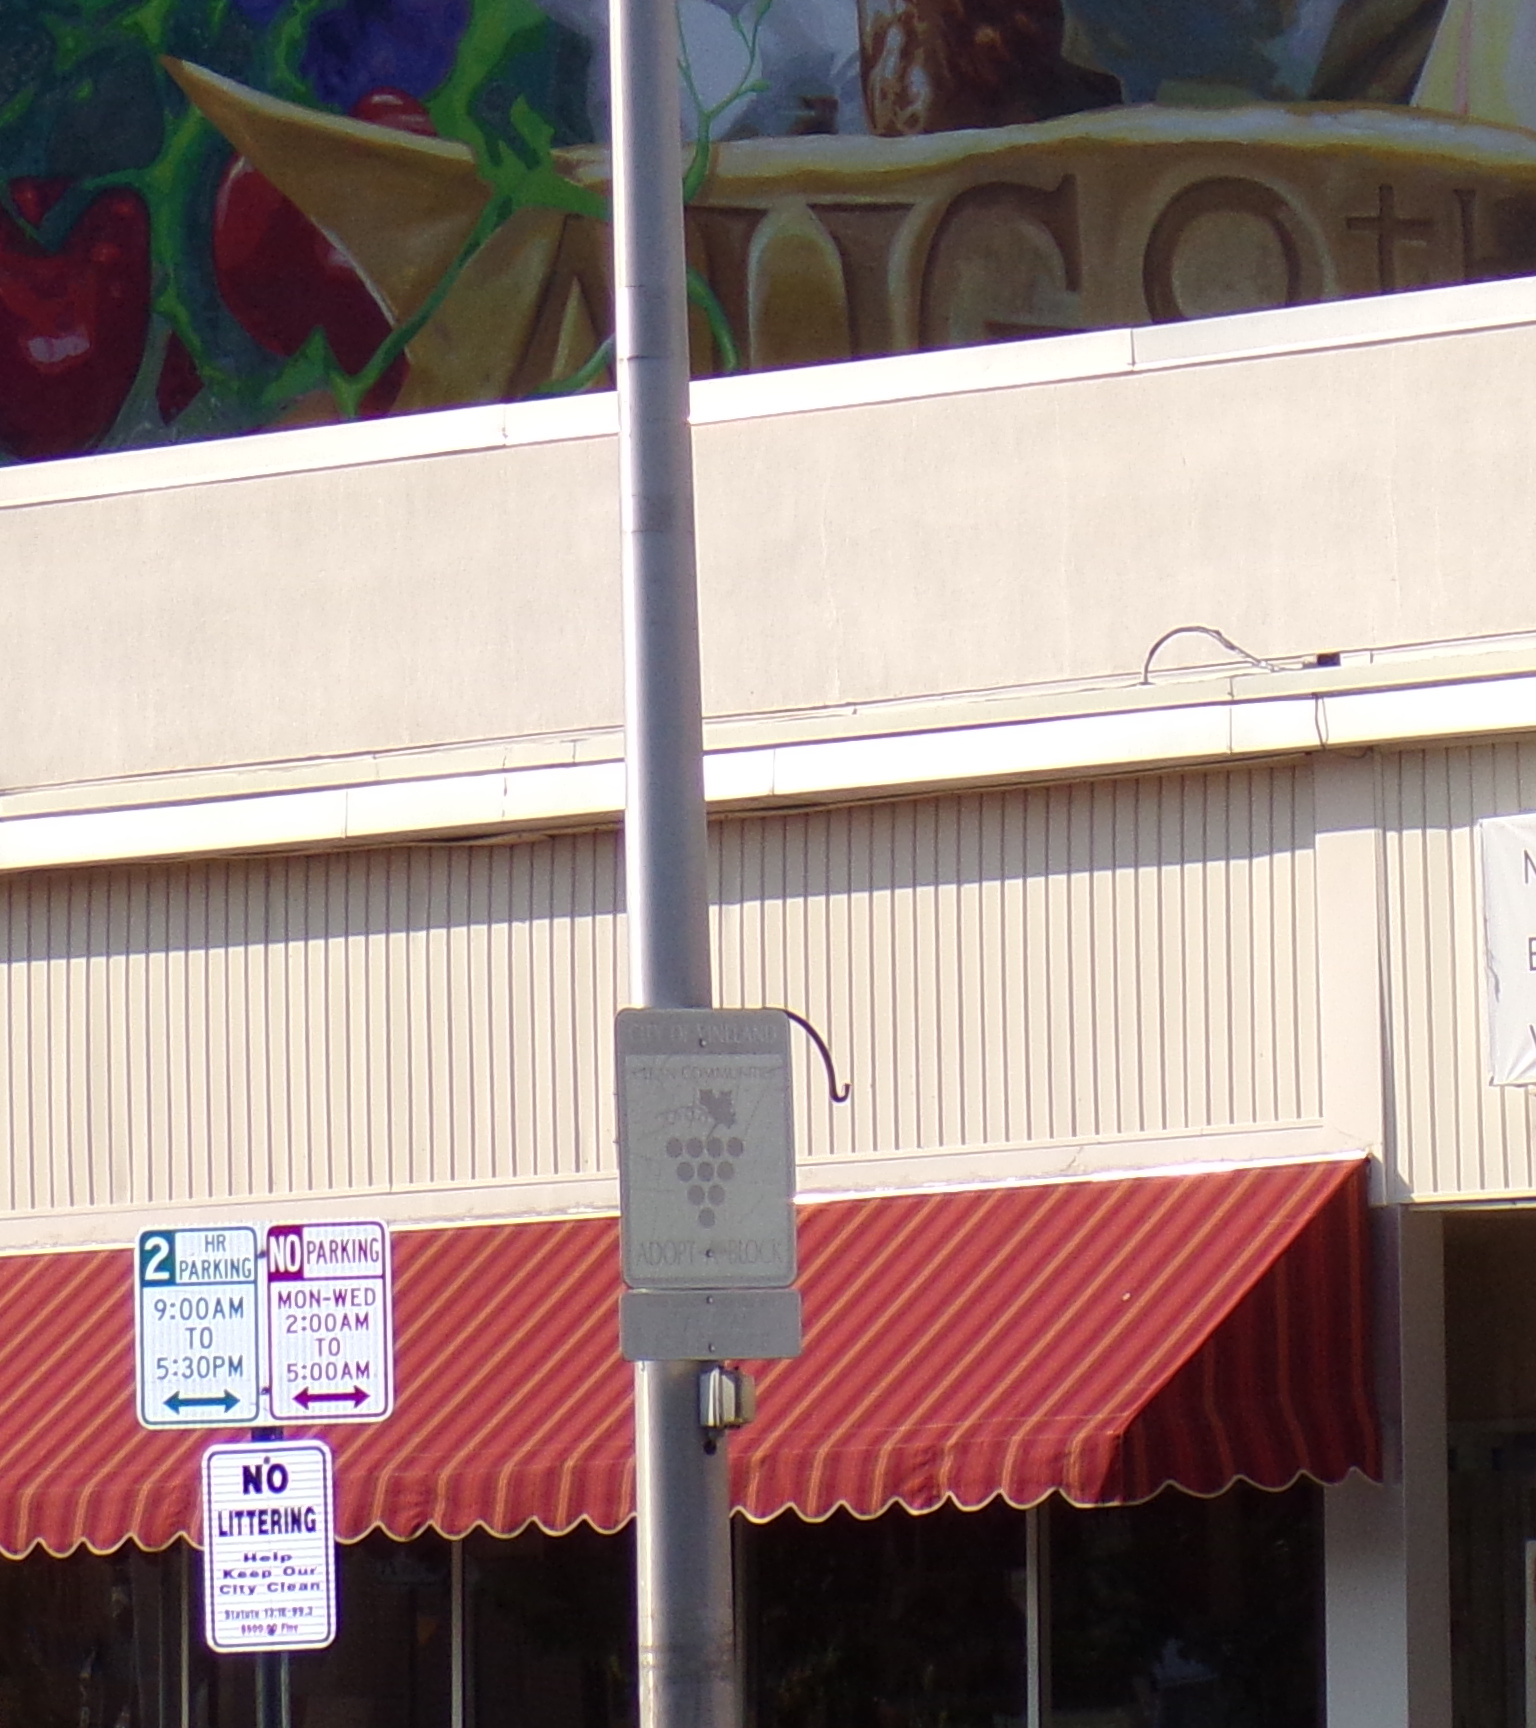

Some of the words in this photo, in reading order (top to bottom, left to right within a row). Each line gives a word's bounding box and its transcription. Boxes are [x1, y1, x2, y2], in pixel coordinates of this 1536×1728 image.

[144, 1236, 170, 1280] 2
[204, 1234, 226, 1252] HR
[269, 1234, 301, 1273] NO
[306, 1238, 380, 1264] PARKING
[179, 1258, 252, 1280] PARKING
[154, 1296, 244, 1321] 9:00AM
[278, 1288, 376, 1309] MON-WED
[285, 1312, 369, 1333] 2:00AM
[185, 1327, 213, 1349] TO
[315, 1337, 341, 1357] TO
[156, 1355, 243, 1380] 5:30PM
[287, 1361, 370, 1382] 5:00AM
[242, 1463, 289, 1495] NO
[218, 1507, 316, 1537] LITTERING
[243, 1552, 292, 1563] Help
[223, 1569, 272, 1580] Keep
[283, 1566, 317, 1577] Our
[220, 1584, 257, 1595] City
[267, 1582, 320, 1593] Clean
